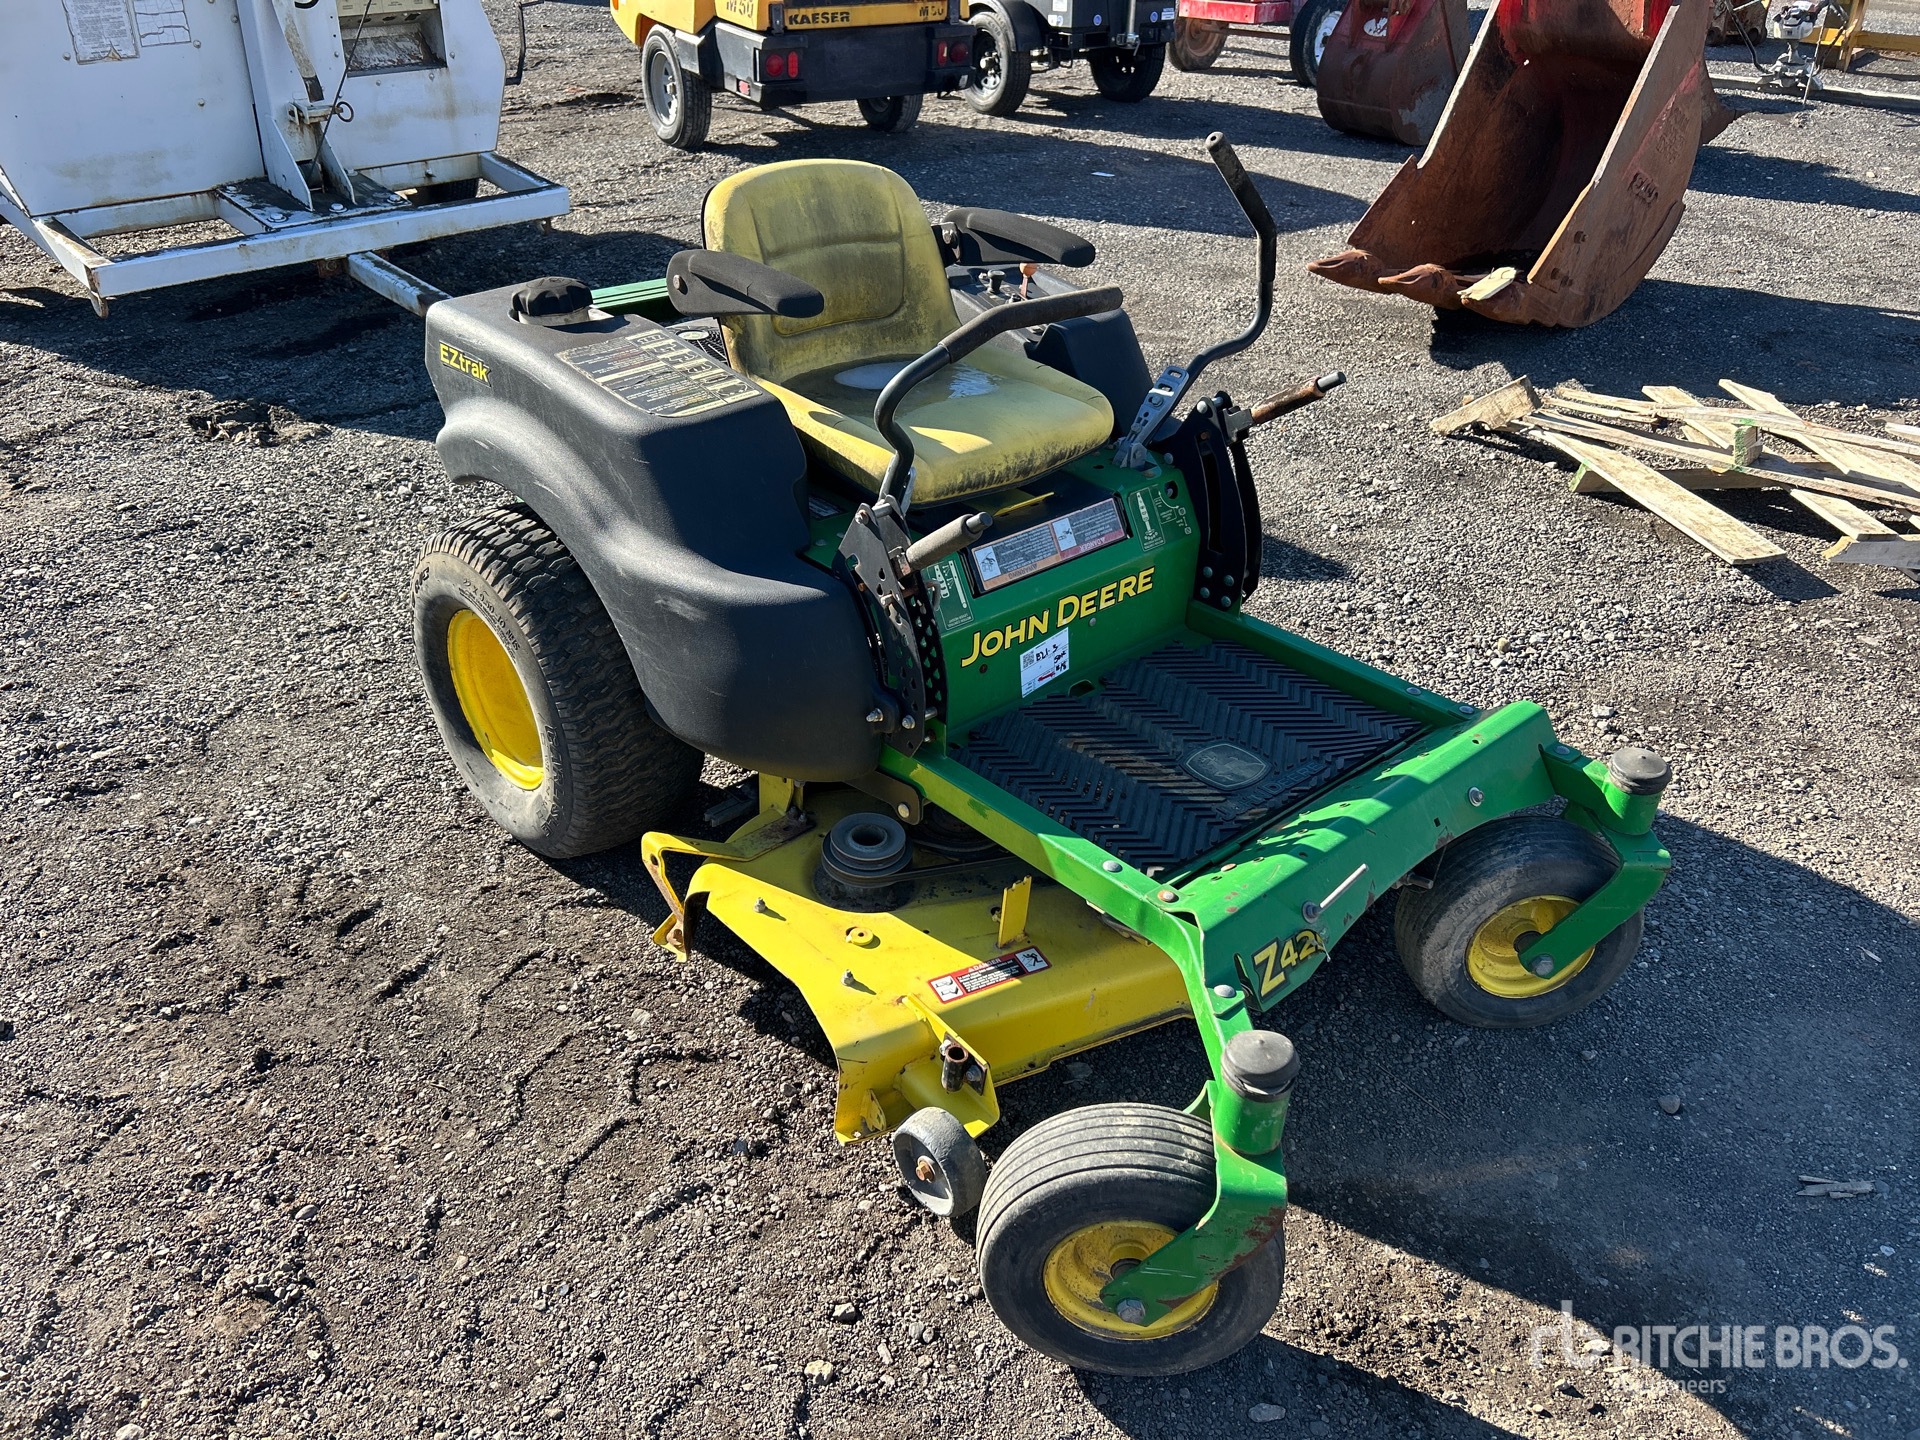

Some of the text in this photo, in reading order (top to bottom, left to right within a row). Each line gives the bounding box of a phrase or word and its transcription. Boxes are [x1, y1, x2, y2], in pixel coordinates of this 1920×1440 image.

[788, 11, 851, 26] KAESER
[438, 341, 491, 384] EZtrak
[1079, 538, 1101, 552] DANGER
[961, 566, 1156, 668] JOHN DEERE
[972, 957, 1002, 972] DANGER
